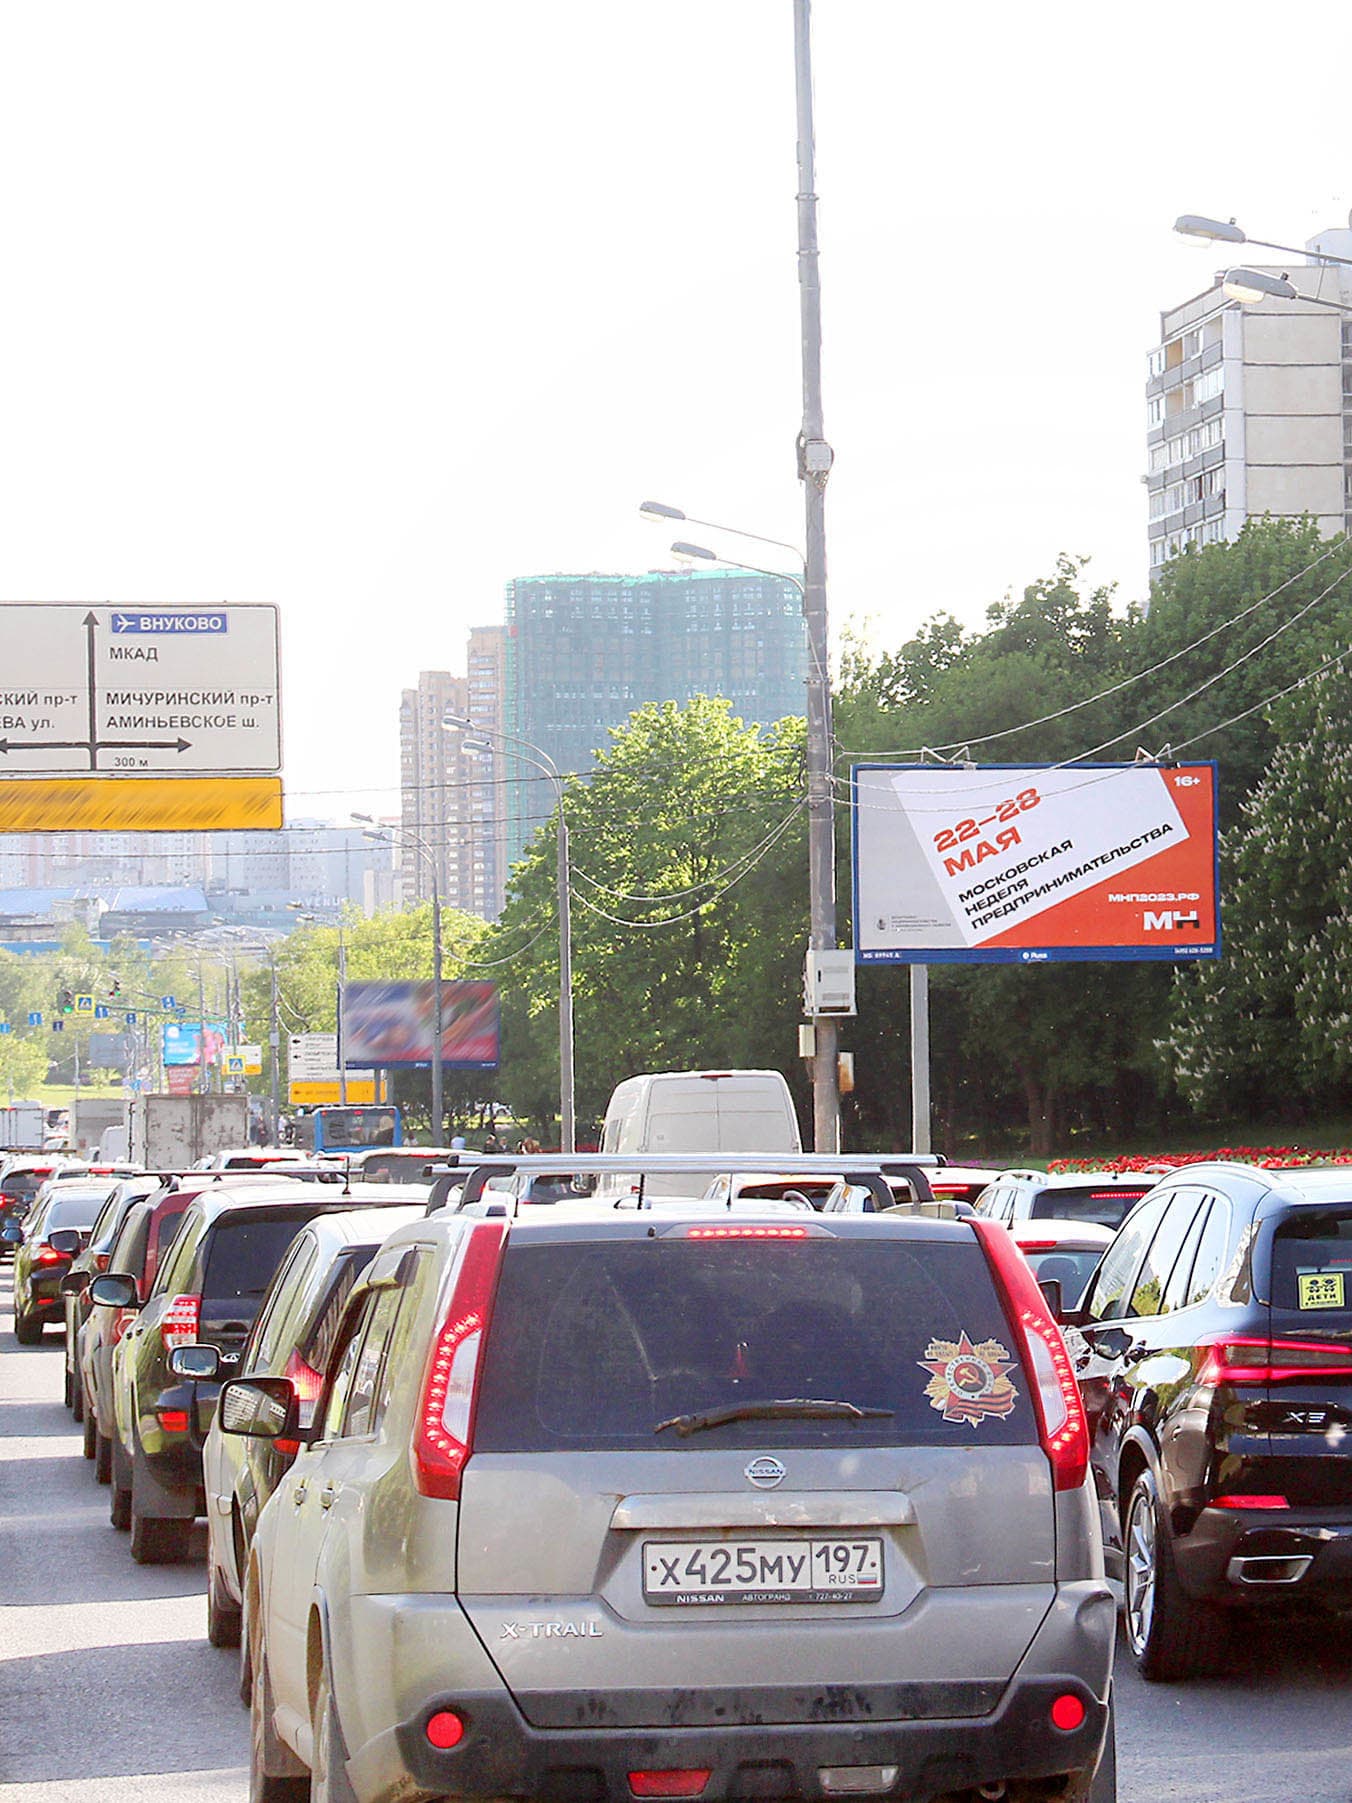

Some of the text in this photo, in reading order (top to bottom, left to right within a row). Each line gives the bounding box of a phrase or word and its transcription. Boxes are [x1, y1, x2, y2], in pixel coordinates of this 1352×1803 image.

[140, 617, 223, 631] ВНУКОВО
[109, 647, 158, 662] МКАД
[0, 690, 78, 708] КИЙ пр-т
[106, 690, 273, 707] МИЧУРИНСКИЙ пр-т
[0, 716, 55, 732] ВА ул.
[106, 715, 260, 729] АМИНЬЕВСКОЕ ш.
[114, 757, 149, 767] 300 м
[1174, 775, 1201, 787] 16+
[943, 826, 1022, 877] МАЯ
[958, 839, 1074, 903] МОСКОВСКАЯ
[971, 823, 1173, 930] ПРЕДПРИНИМАТЕЛЬСТВА
[964, 878, 1029, 916] НЕДЕЛЯ
[1108, 893, 1200, 903] МНП2023.РФ
[748, 1468, 784, 1476] NISSAN
[815, 1544, 870, 1574] 197
[828, 1573, 857, 1585] RUS
[677, 1594, 725, 1603] NISSAN
[500, 1621, 603, 1639] X-TRAIL
